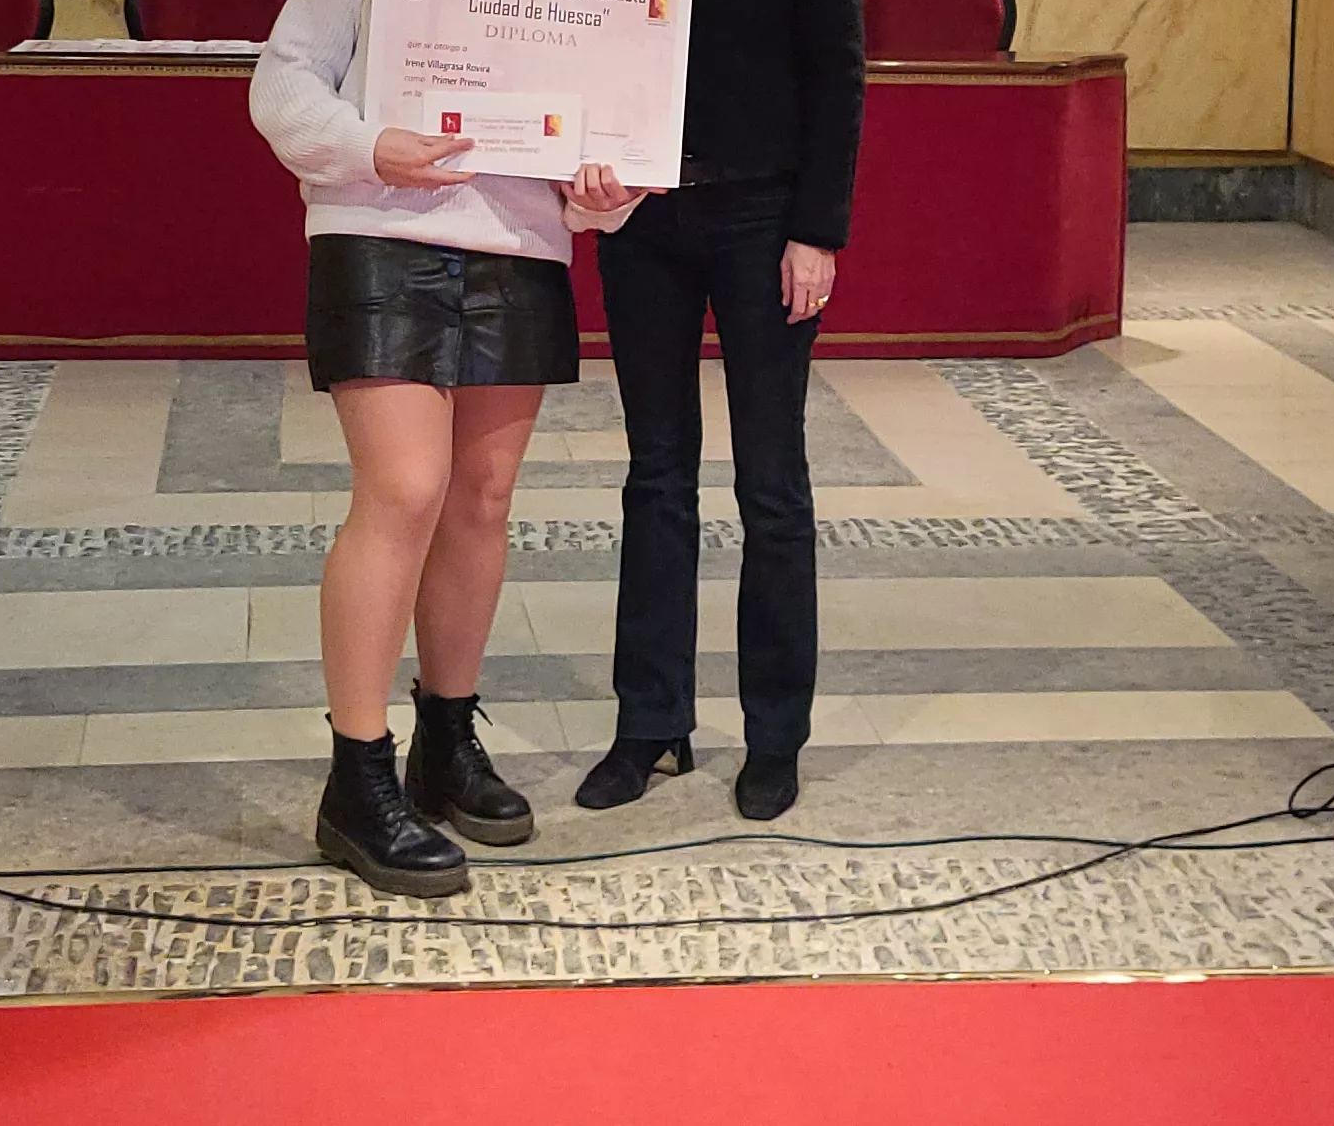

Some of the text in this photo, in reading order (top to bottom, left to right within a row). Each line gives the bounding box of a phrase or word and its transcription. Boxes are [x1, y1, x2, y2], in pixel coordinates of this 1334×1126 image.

[524, 0, 543, 20] de
[485, 24, 578, 47] DIPLOMA
[405, 58, 491, 74] Irene Villagrasa Rovira
[432, 74, 457, 85] Primer
[459, 77, 487, 88] Premio
